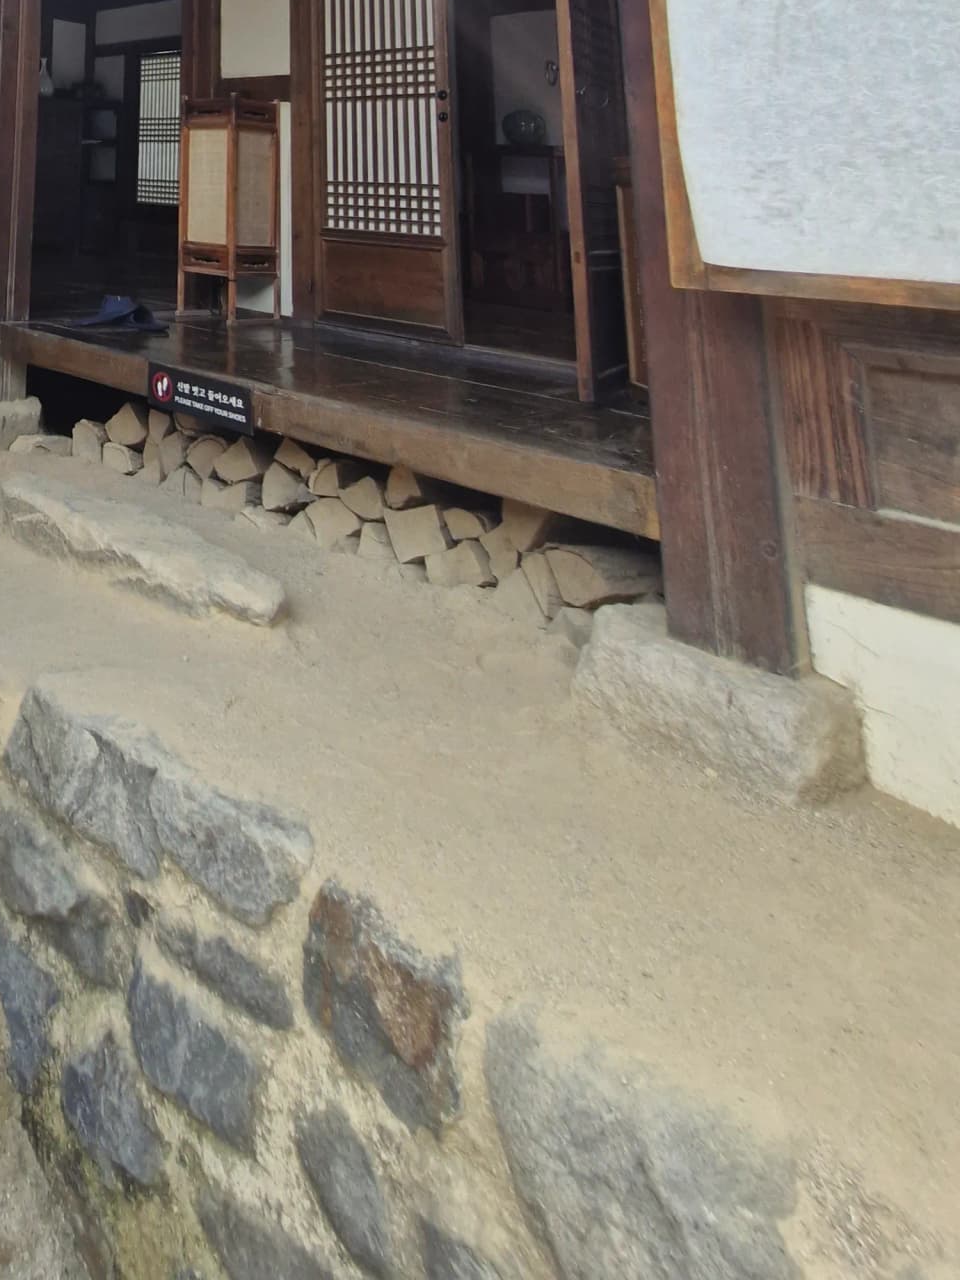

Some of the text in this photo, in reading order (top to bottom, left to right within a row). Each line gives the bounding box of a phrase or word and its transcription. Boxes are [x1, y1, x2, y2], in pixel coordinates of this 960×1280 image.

[174, 395, 246, 423] PLEASE TAKE OFF YOUR SHOES
[177, 381, 244, 409] 신발 벗고 들어오세요
